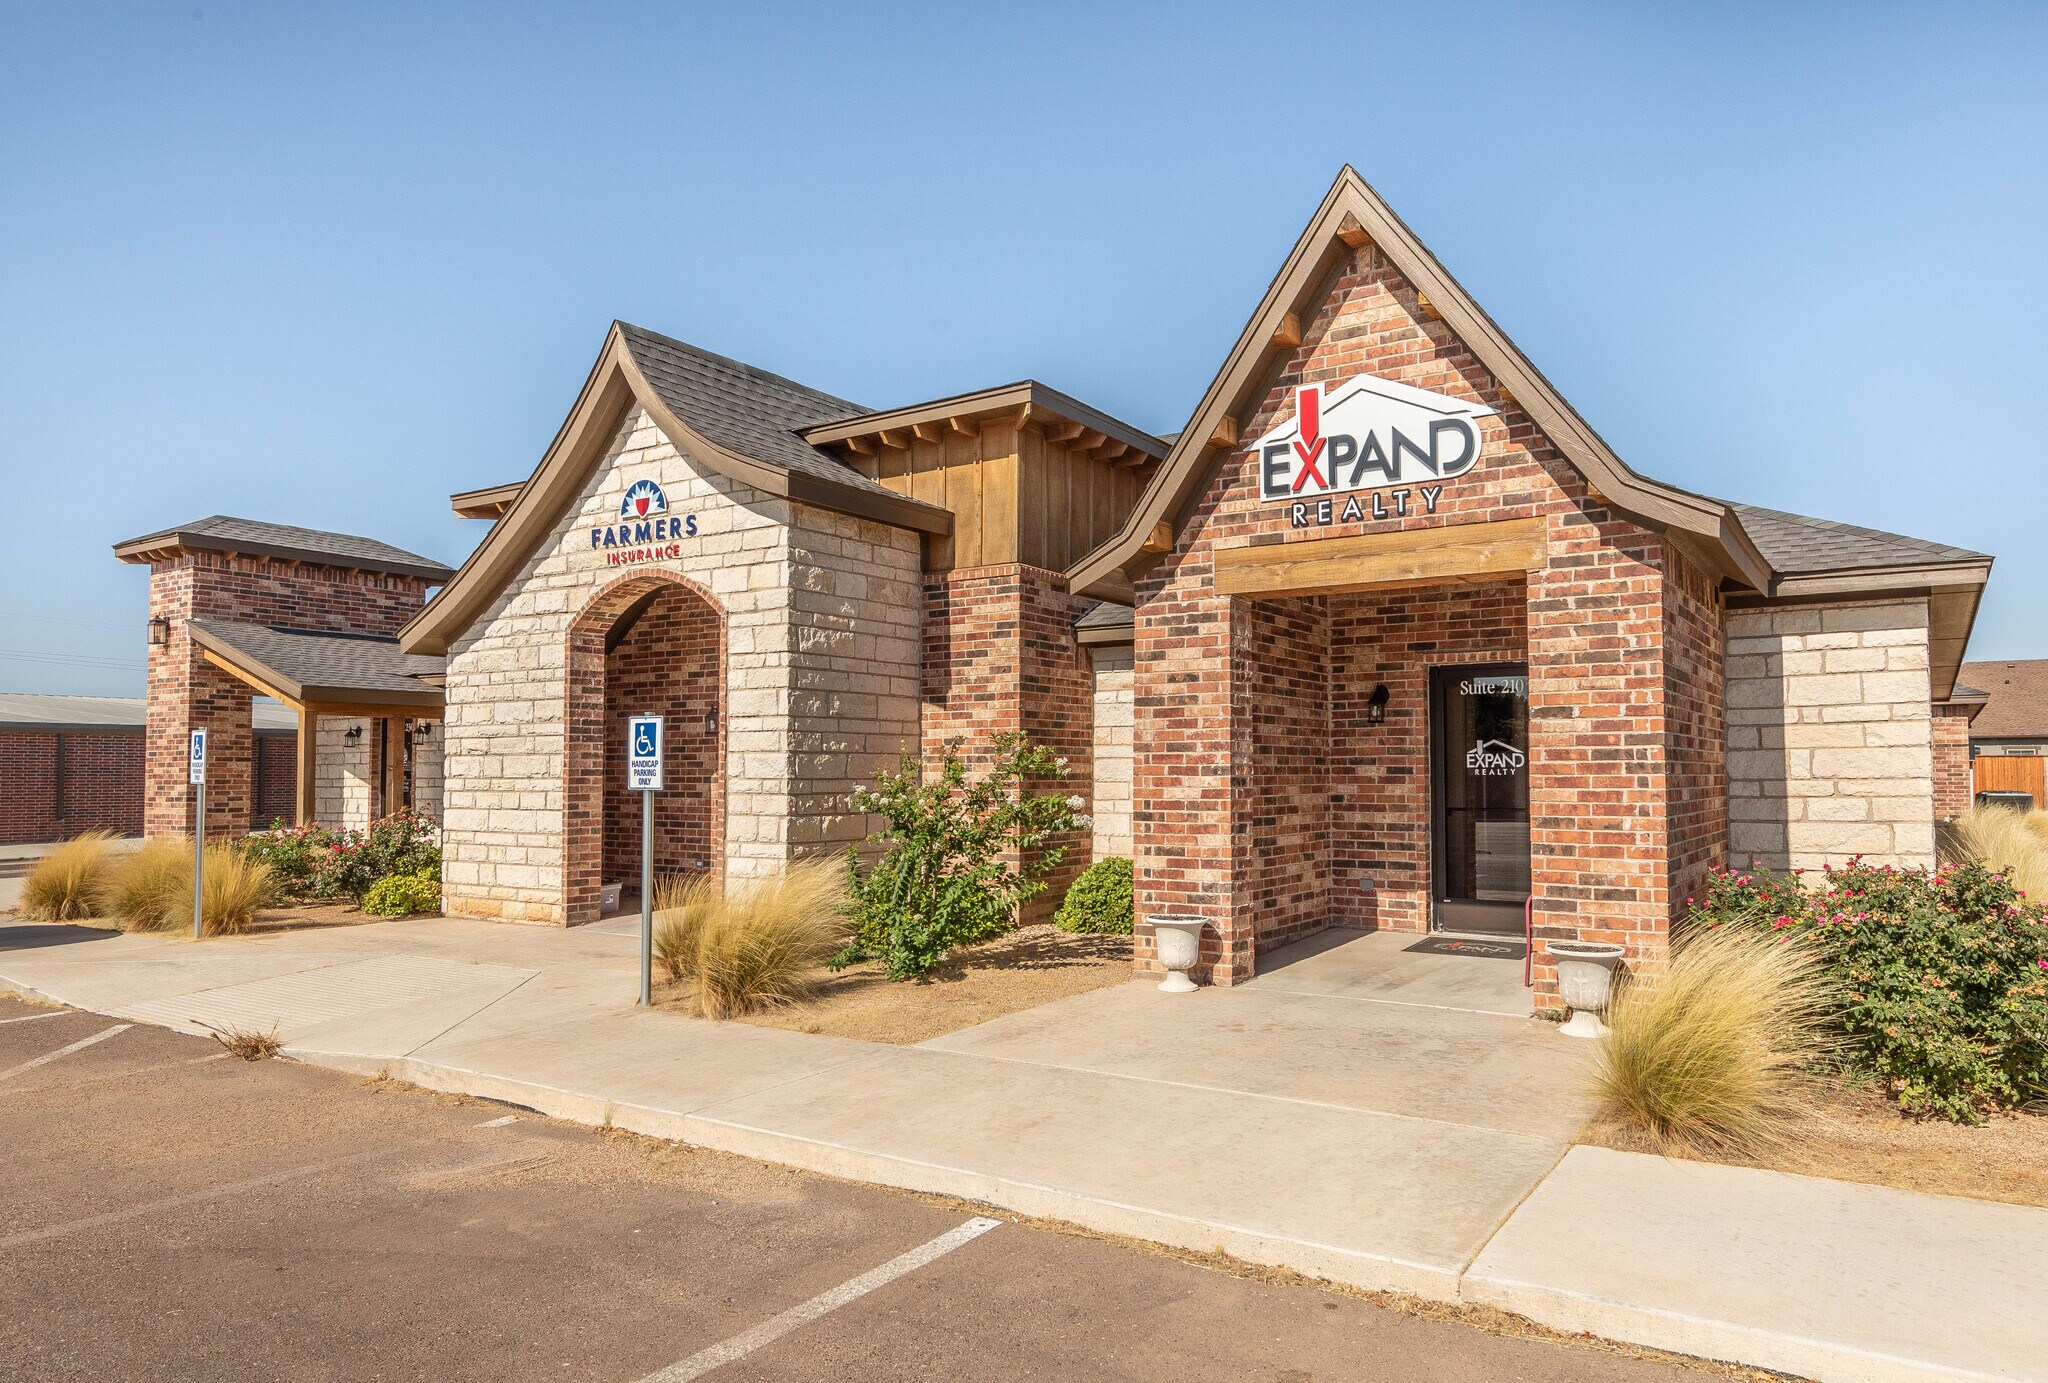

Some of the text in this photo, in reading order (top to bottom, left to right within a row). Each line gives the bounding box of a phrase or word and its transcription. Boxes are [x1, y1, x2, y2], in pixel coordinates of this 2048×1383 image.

[1264, 417, 1476, 495] EXPAND
[1291, 485, 1443, 529] REALTY
[591, 514, 698, 549] FARMERS
[606, 544, 680, 566] INSURANCE
[1460, 679, 1524, 696] Suite 210
[631, 760, 659, 768] HANDICAP
[1466, 753, 1525, 768] EXPAND
[633, 768, 657, 777] PARKING
[1474, 768, 1516, 776] REALTY
[638, 777, 652, 786] ONLY
